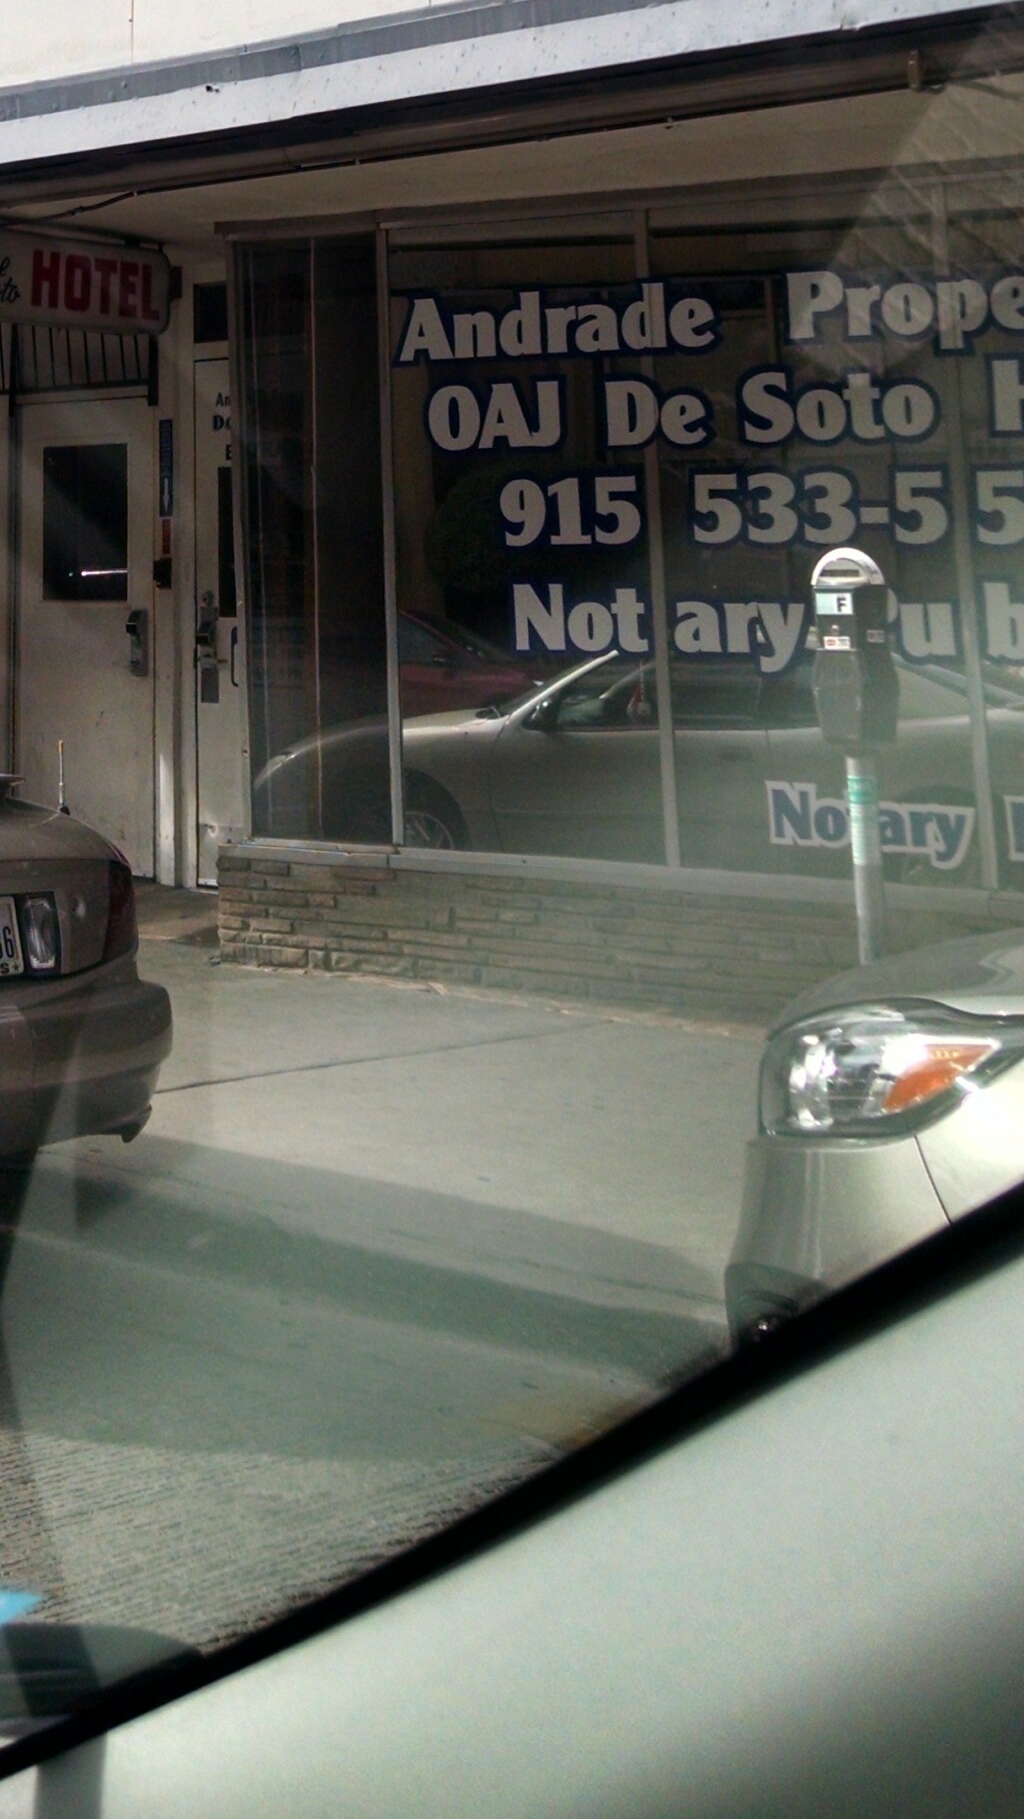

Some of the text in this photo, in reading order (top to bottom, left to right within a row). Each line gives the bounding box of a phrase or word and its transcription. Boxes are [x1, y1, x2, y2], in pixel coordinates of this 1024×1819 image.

[31, 248, 161, 322] HOTEL
[398, 281, 716, 362] Andrade
[428, 381, 562, 451] OAJ
[605, 381, 714, 446] De
[742, 372, 935, 445] Soto
[499, 476, 642, 547] 915
[767, 782, 973, 867] Noary
